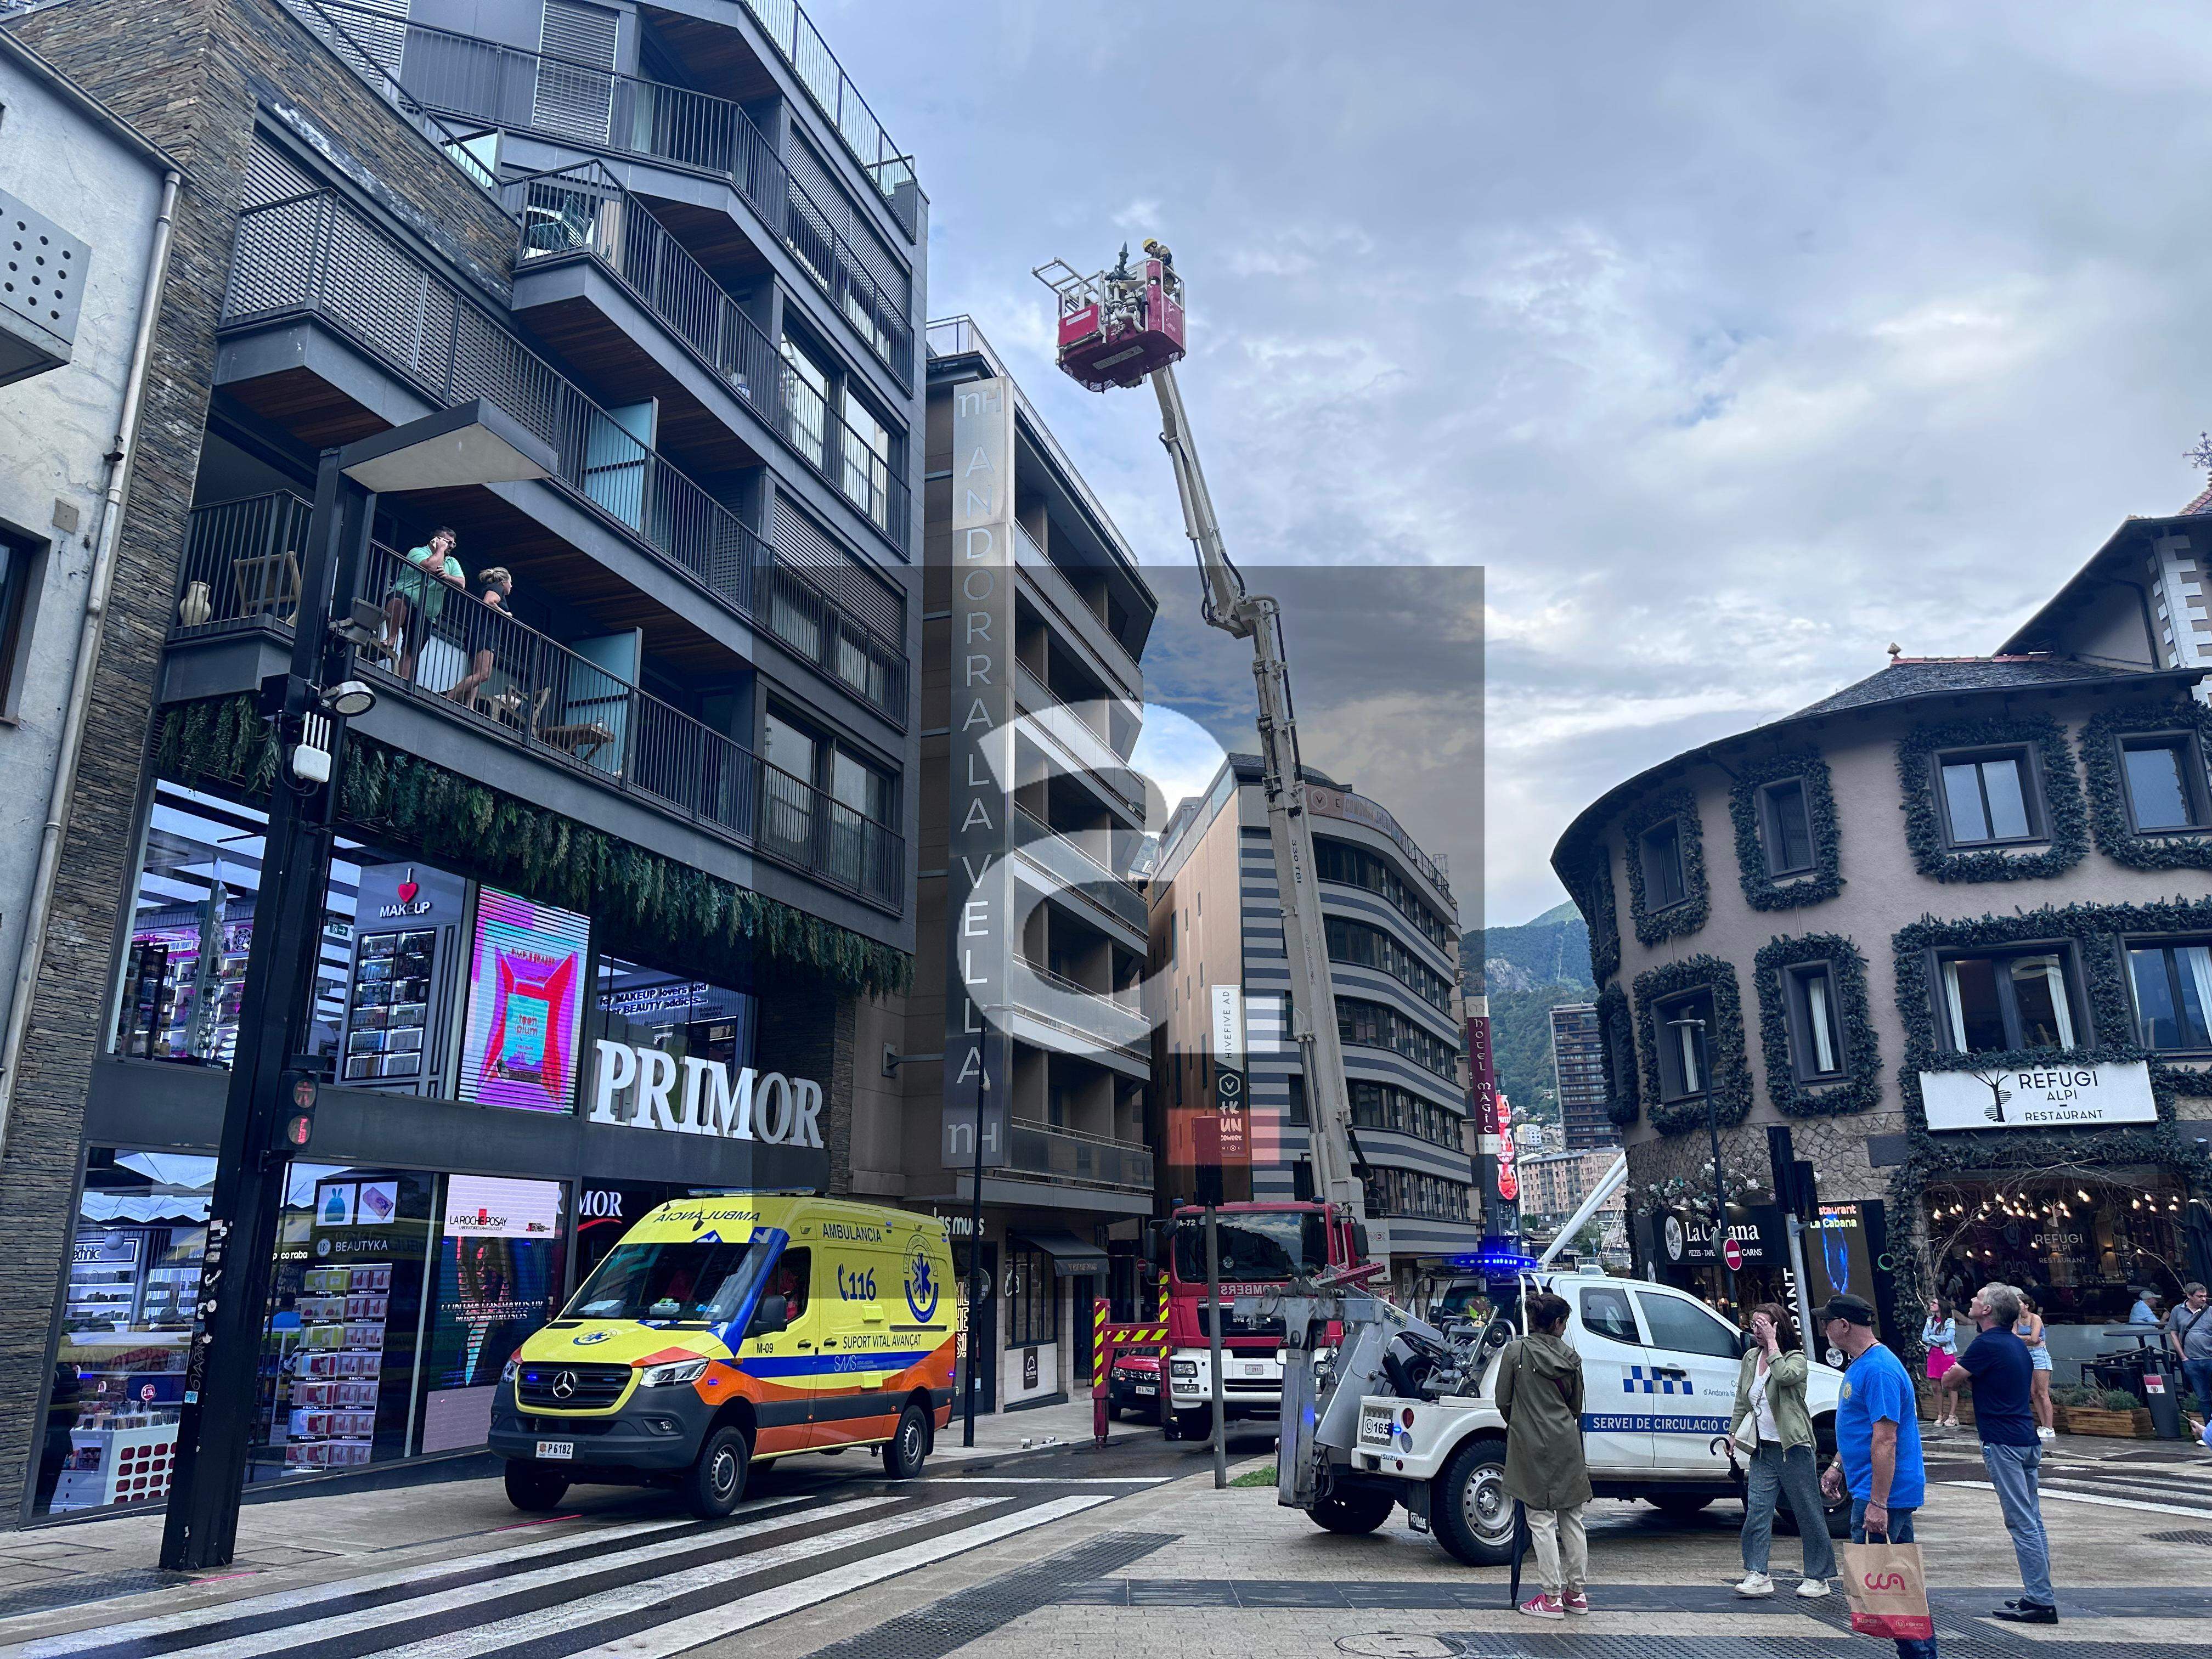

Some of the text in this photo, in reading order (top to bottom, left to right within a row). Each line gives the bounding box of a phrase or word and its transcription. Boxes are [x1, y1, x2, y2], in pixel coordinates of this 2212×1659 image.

[962, 444, 995, 731] ANDORRA
[379, 901, 431, 917] MAKEUP
[956, 854, 992, 1085] VELLA
[616, 989, 656, 1003] MAKEUP
[659, 986, 687, 997] lovers
[624, 1001, 662, 1014] BEAUTY
[2018, 1070, 2098, 1089] REFUGI
[589, 1039, 823, 1149] PRIMOR
[2025, 1109, 2103, 1121] RESTAURANT
[1220, 1118, 1242, 1132] UN
[1818, 1204, 1857, 1215] staurant
[450, 1216, 459, 1224] LA
[952, 1216, 985, 1236] mus
[1822, 1218, 1857, 1228] Cabana
[823, 1221, 883, 1243] AMBULÀNCIA
[1684, 1219, 1760, 1242] La Cana
[335, 1240, 388, 1251] BEAUTYKA
[2035, 1233, 2083, 1244] REFUGI
[849, 1267, 876, 1301] 116
[757, 1343, 774, 1353] M-09
[843, 1334, 921, 1350] SUPORT VITAL AVANÇAT
[1374, 1422, 1389, 1435] 165
[1593, 1417, 1632, 1429] SERVEI
[1637, 1418, 1650, 1429] DE
[1655, 1417, 1718, 1431] CIRCULACIÓ
[548, 1443, 571, 1454] P 6182
